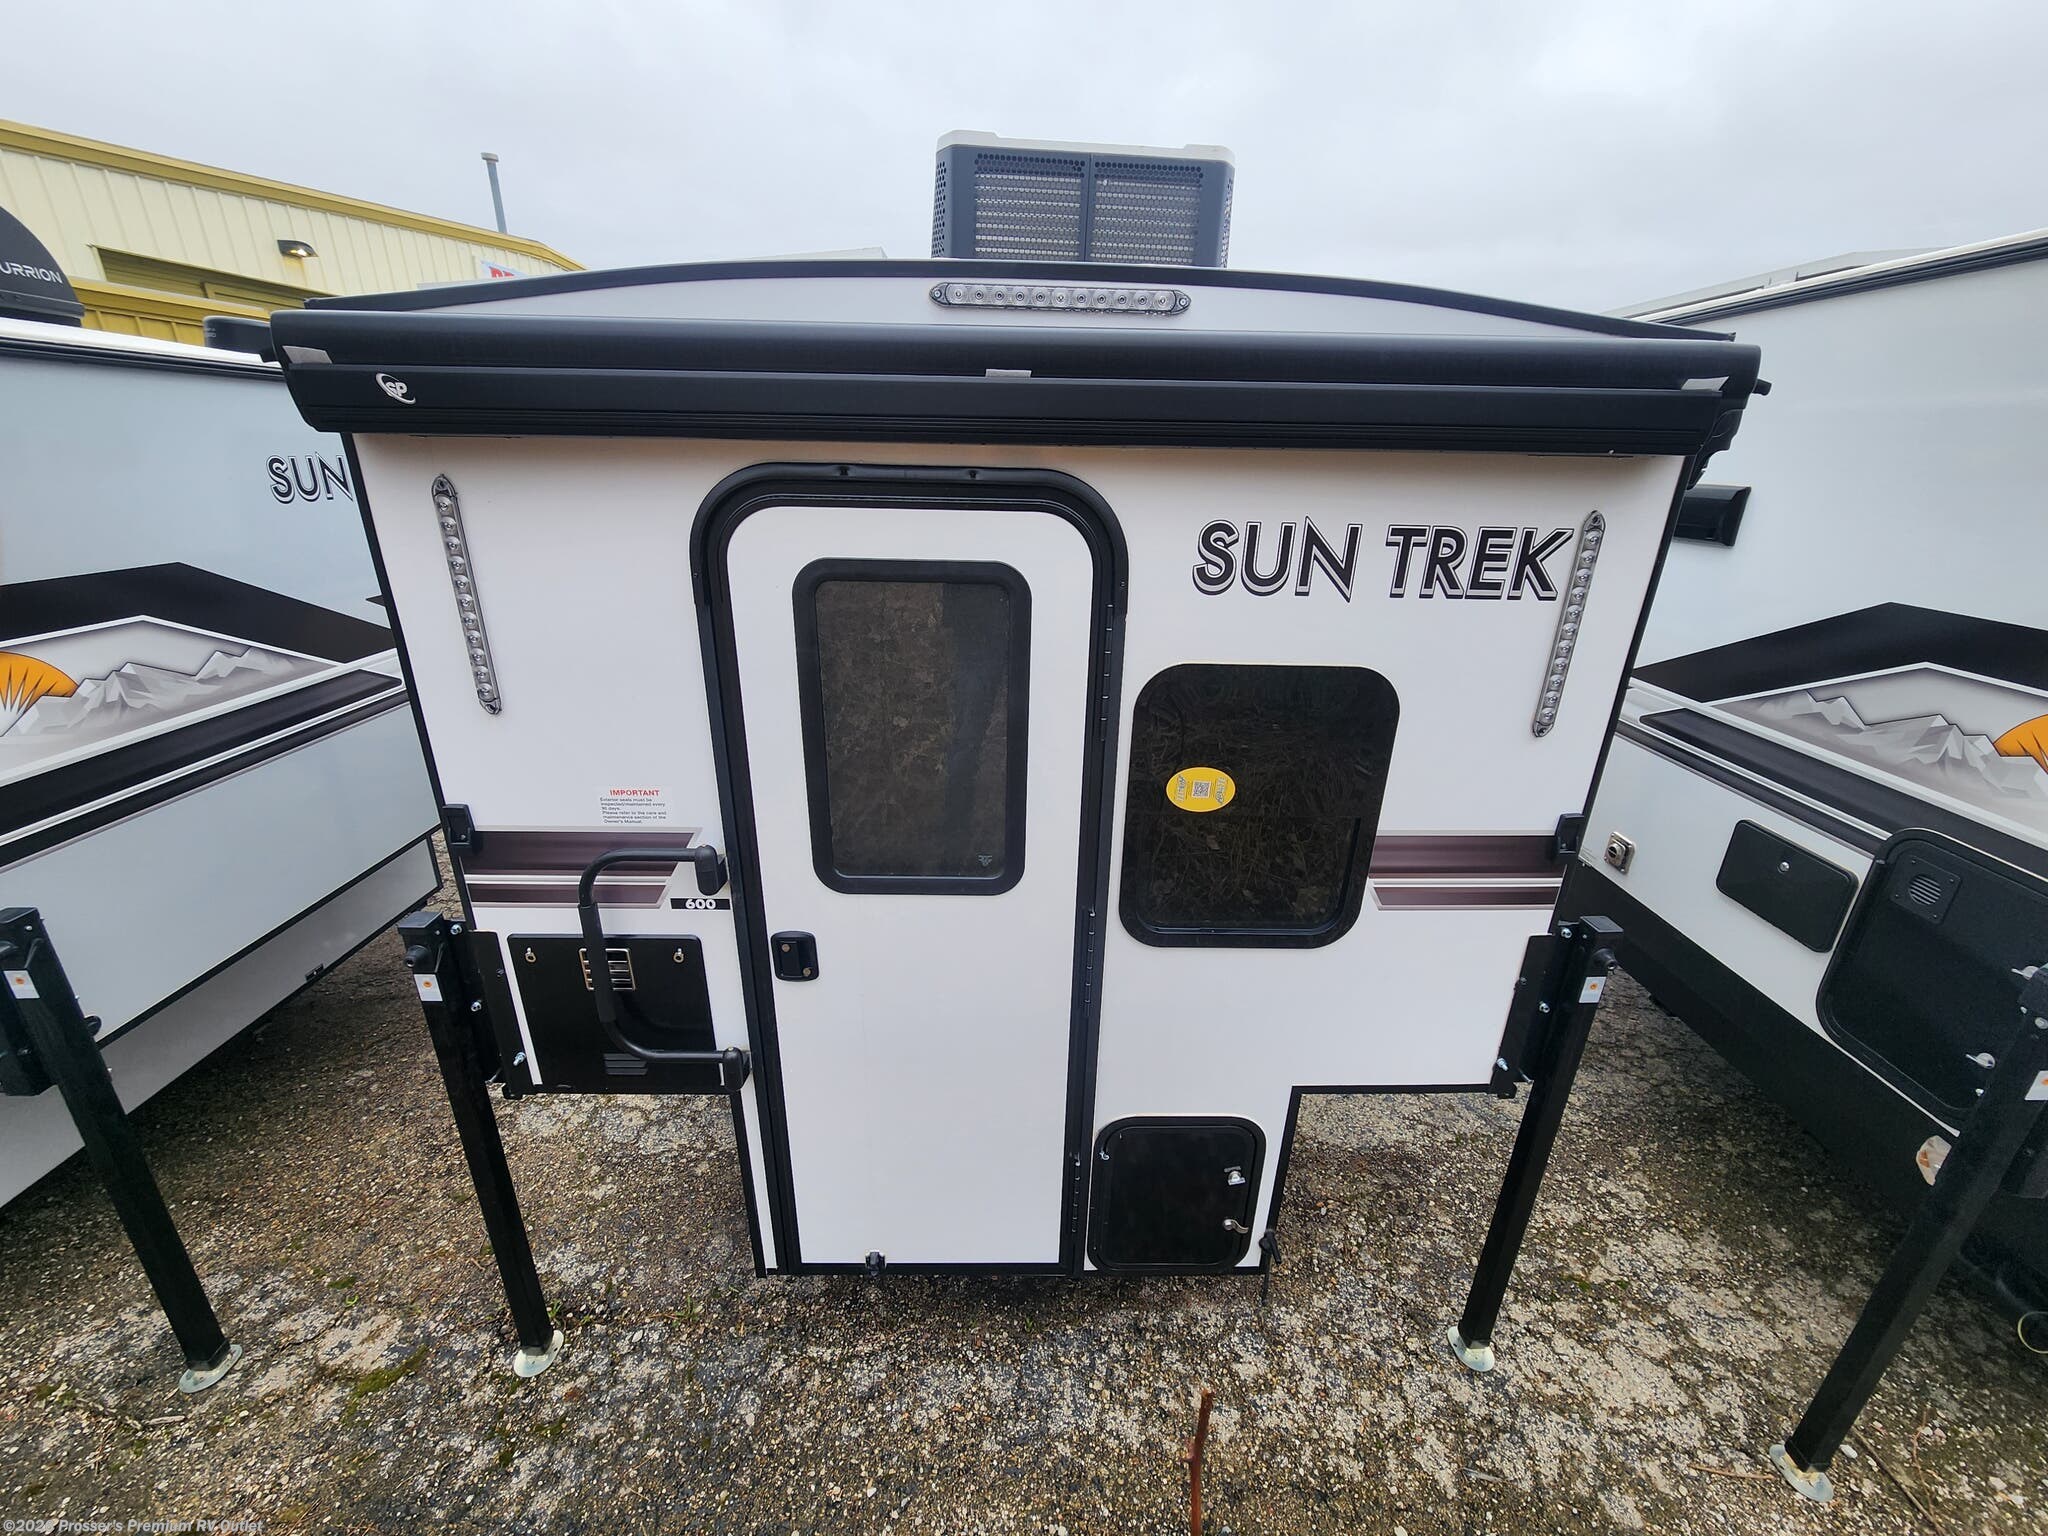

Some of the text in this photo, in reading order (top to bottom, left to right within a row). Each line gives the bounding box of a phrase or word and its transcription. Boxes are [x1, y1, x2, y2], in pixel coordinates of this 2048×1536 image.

[266, 451, 353, 505] SUN
[1192, 515, 1574, 603] SUN TREK
[609, 789, 660, 797] IMPORTANT
[685, 898, 716, 910] 600
